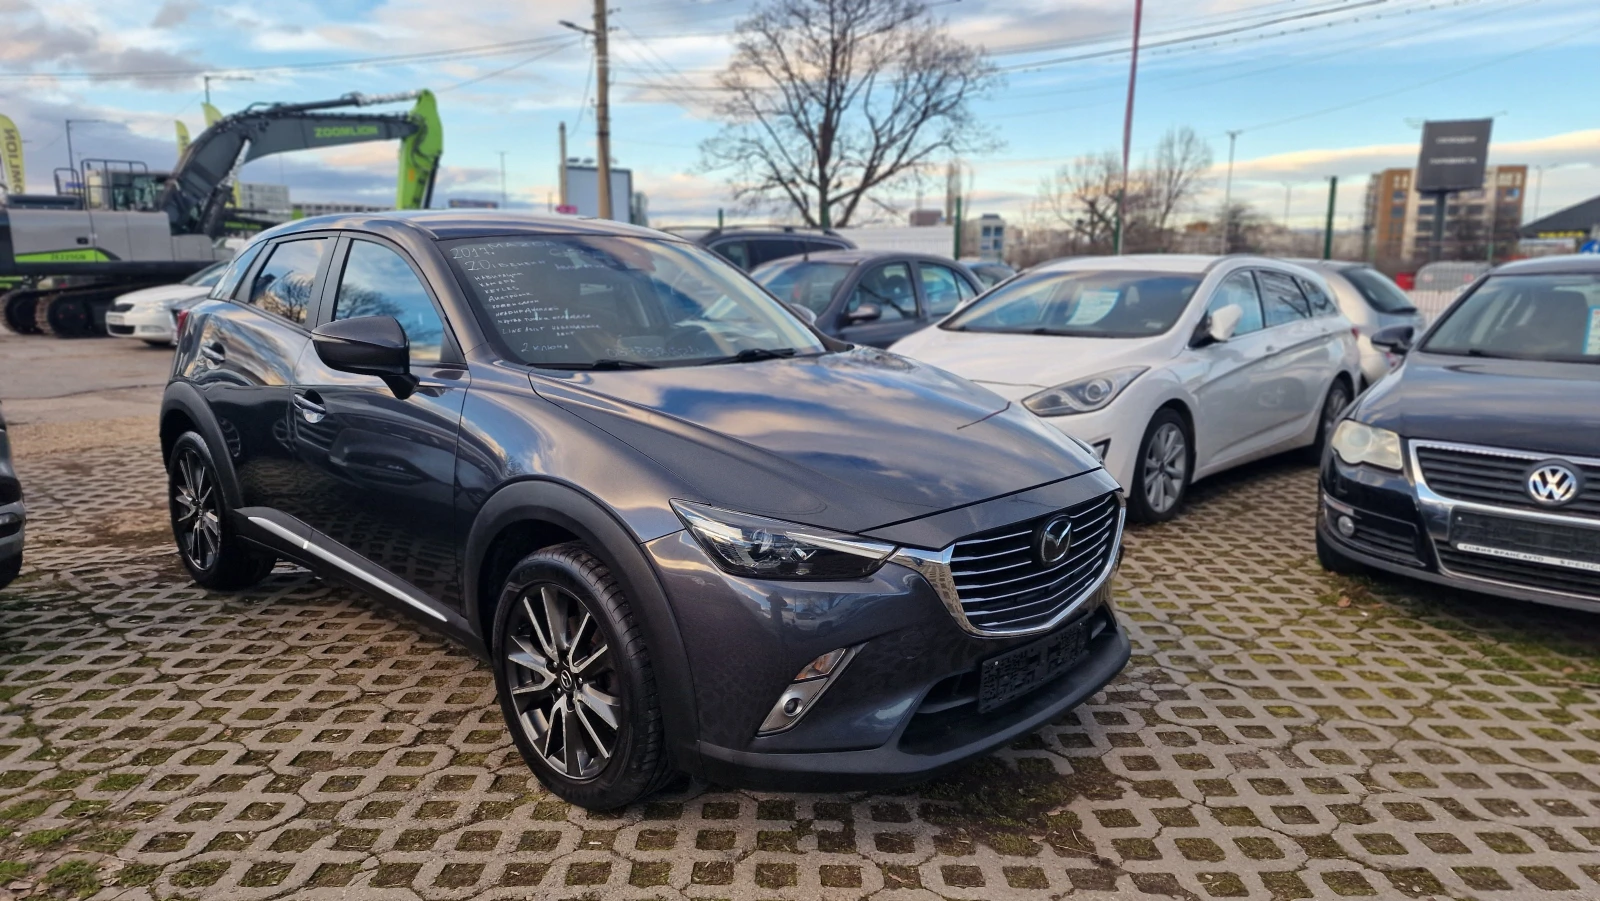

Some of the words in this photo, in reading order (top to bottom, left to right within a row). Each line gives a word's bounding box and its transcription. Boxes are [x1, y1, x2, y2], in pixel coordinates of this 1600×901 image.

[315, 125, 378, 138] ZOOMLION
[521, 342, 529, 353] 2
[1529, 466, 1578, 503] VW
[1567, 561, 1600, 570] PEUG
